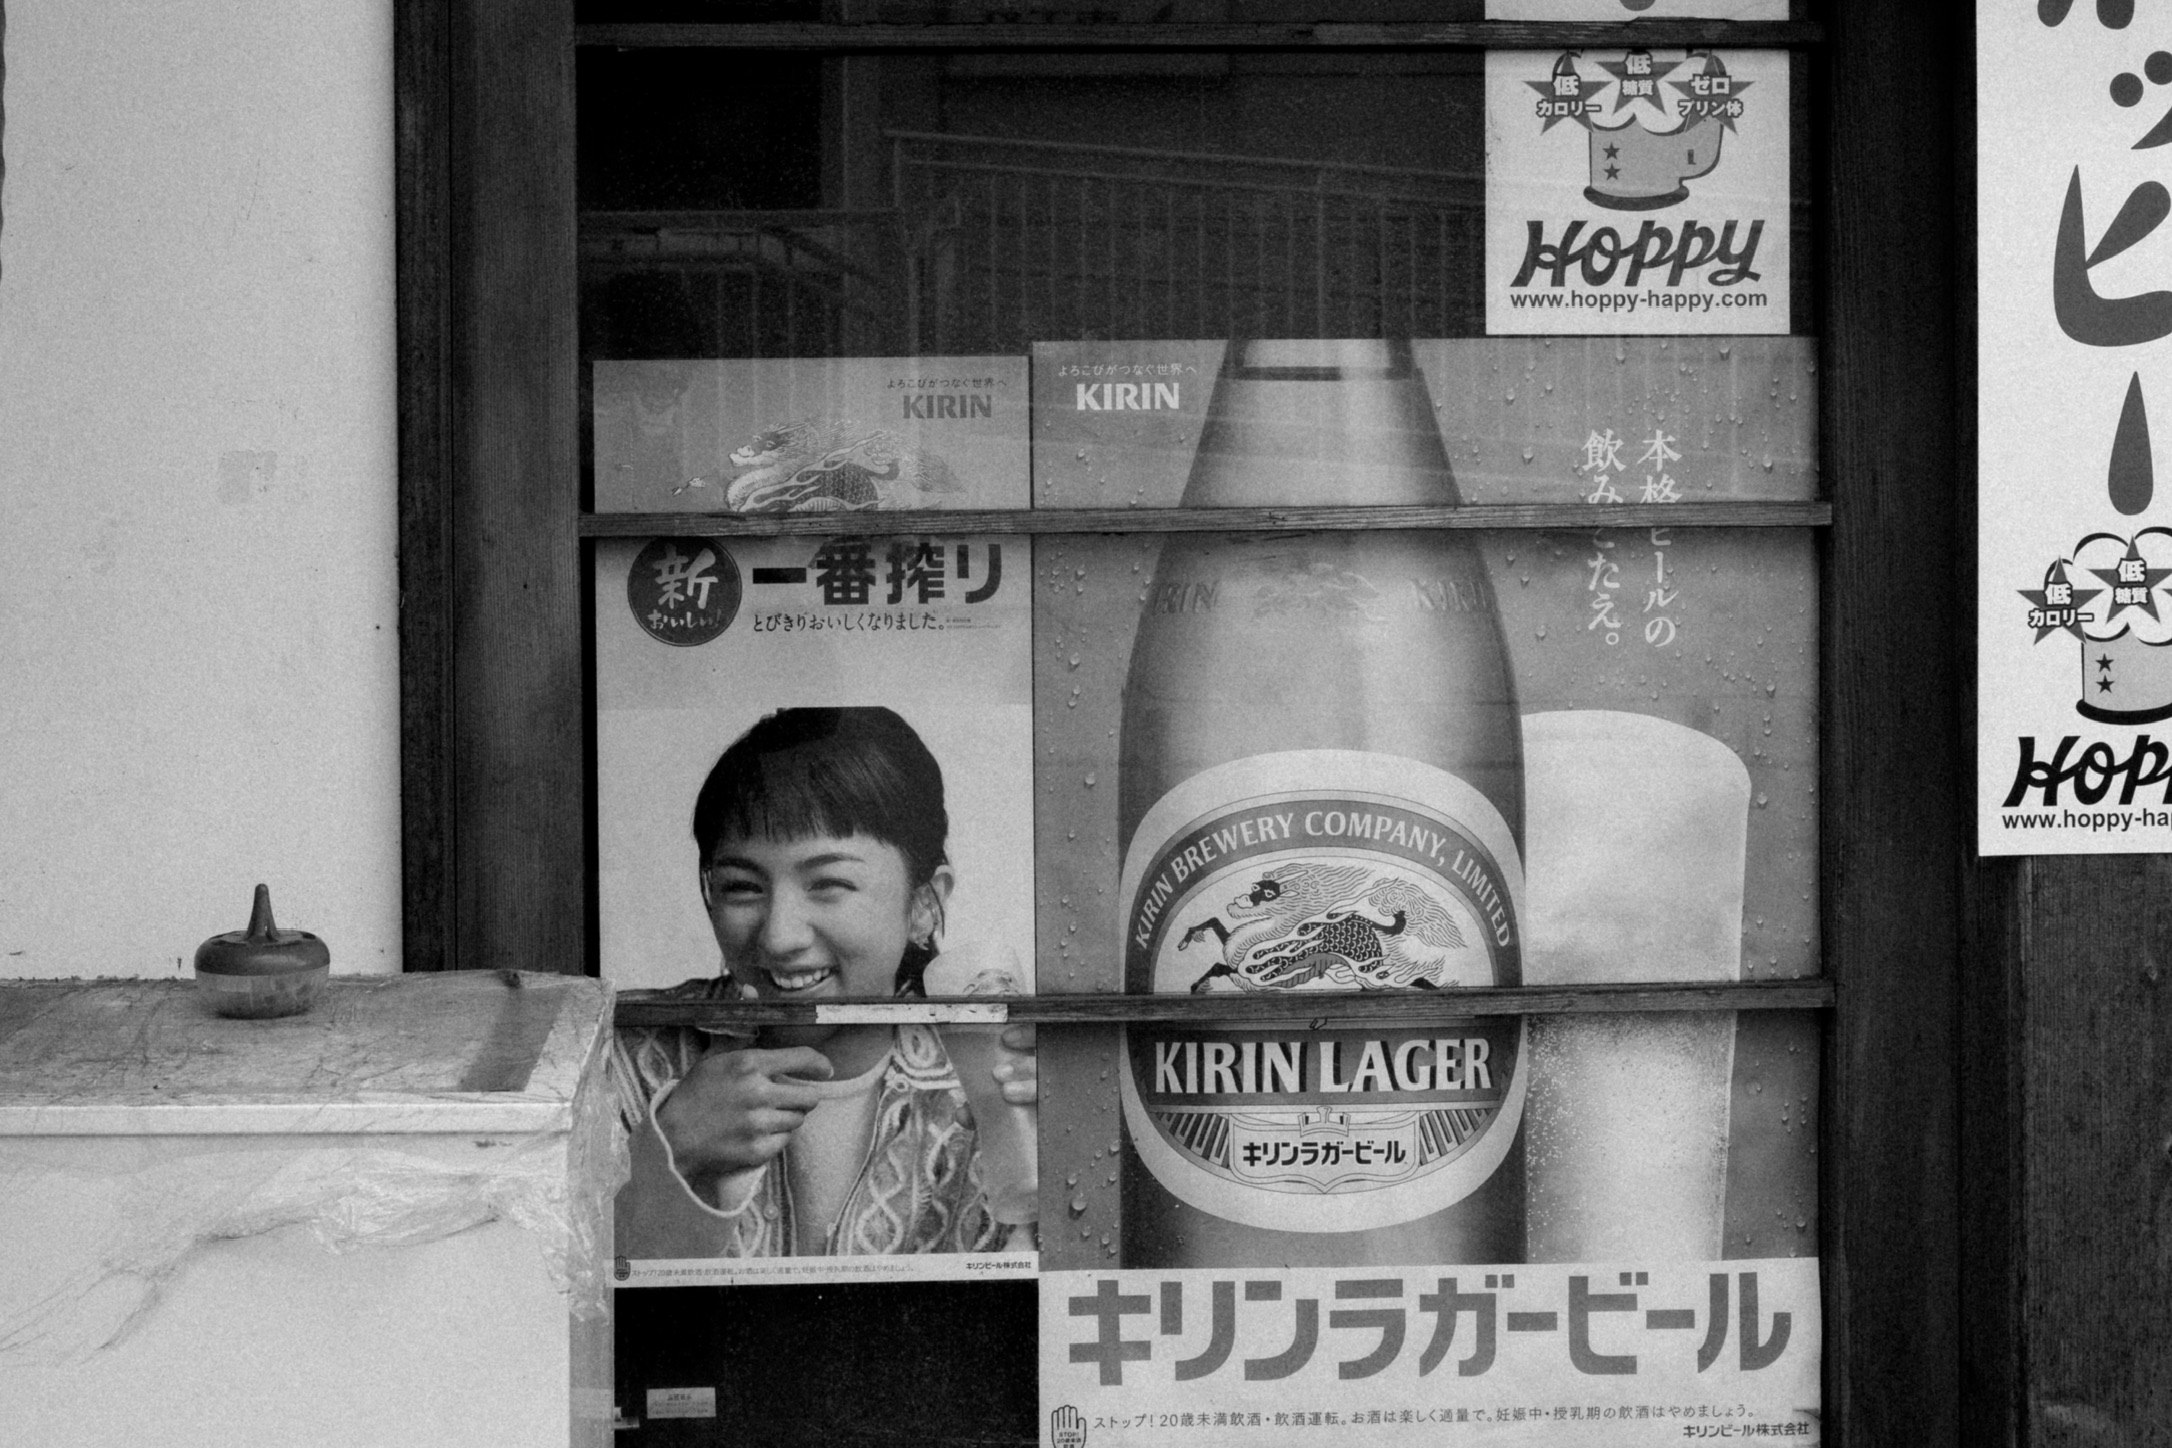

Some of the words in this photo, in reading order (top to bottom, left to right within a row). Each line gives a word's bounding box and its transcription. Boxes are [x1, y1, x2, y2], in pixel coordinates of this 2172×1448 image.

[1625, 51, 1652, 75] 低
[1552, 74, 1580, 97] 低
[1621, 78, 1654, 96] 糖質
[1690, 73, 1732, 96] ゼロ
[1536, 100, 1601, 117] カロリー
[1677, 99, 1744, 117] プリン体
[1510, 290, 1768, 312] www.hoppy-happy.com
[1057, 363, 1198, 377] よろこびがつなぐ世界へ
[903, 394, 992, 419] KIRIN
[1076, 382, 1180, 411] KIRIN
[653, 543, 719, 610] 新
[2117, 557, 2148, 583] 低
[2044, 582, 2073, 606] 低
[2113, 586, 2150, 606] 糖質
[753, 611, 945, 632] とびきりおいしくなりました。
[2027, 608, 2095, 628] カロリー
[2002, 808, 2172, 832] www.hoppy-ha
[1135, 877, 1175, 951] KIRIN
[1171, 811, 1295, 883] BREWERY
[1304, 810, 1447, 867] COMPANY,
[1451, 848, 1511, 948] LIMITED
[1155, 1041, 1304, 1095] KIRIN
[1319, 1037, 1493, 1093] LAGER
[1242, 1139, 1407, 1168] キリンラガービール
[965, 1260, 1032, 1271] キリンビール株式会社
[1068, 1271, 1792, 1386] キリンラガービール
[1683, 1422, 1811, 1439] キリンビール株式会社
